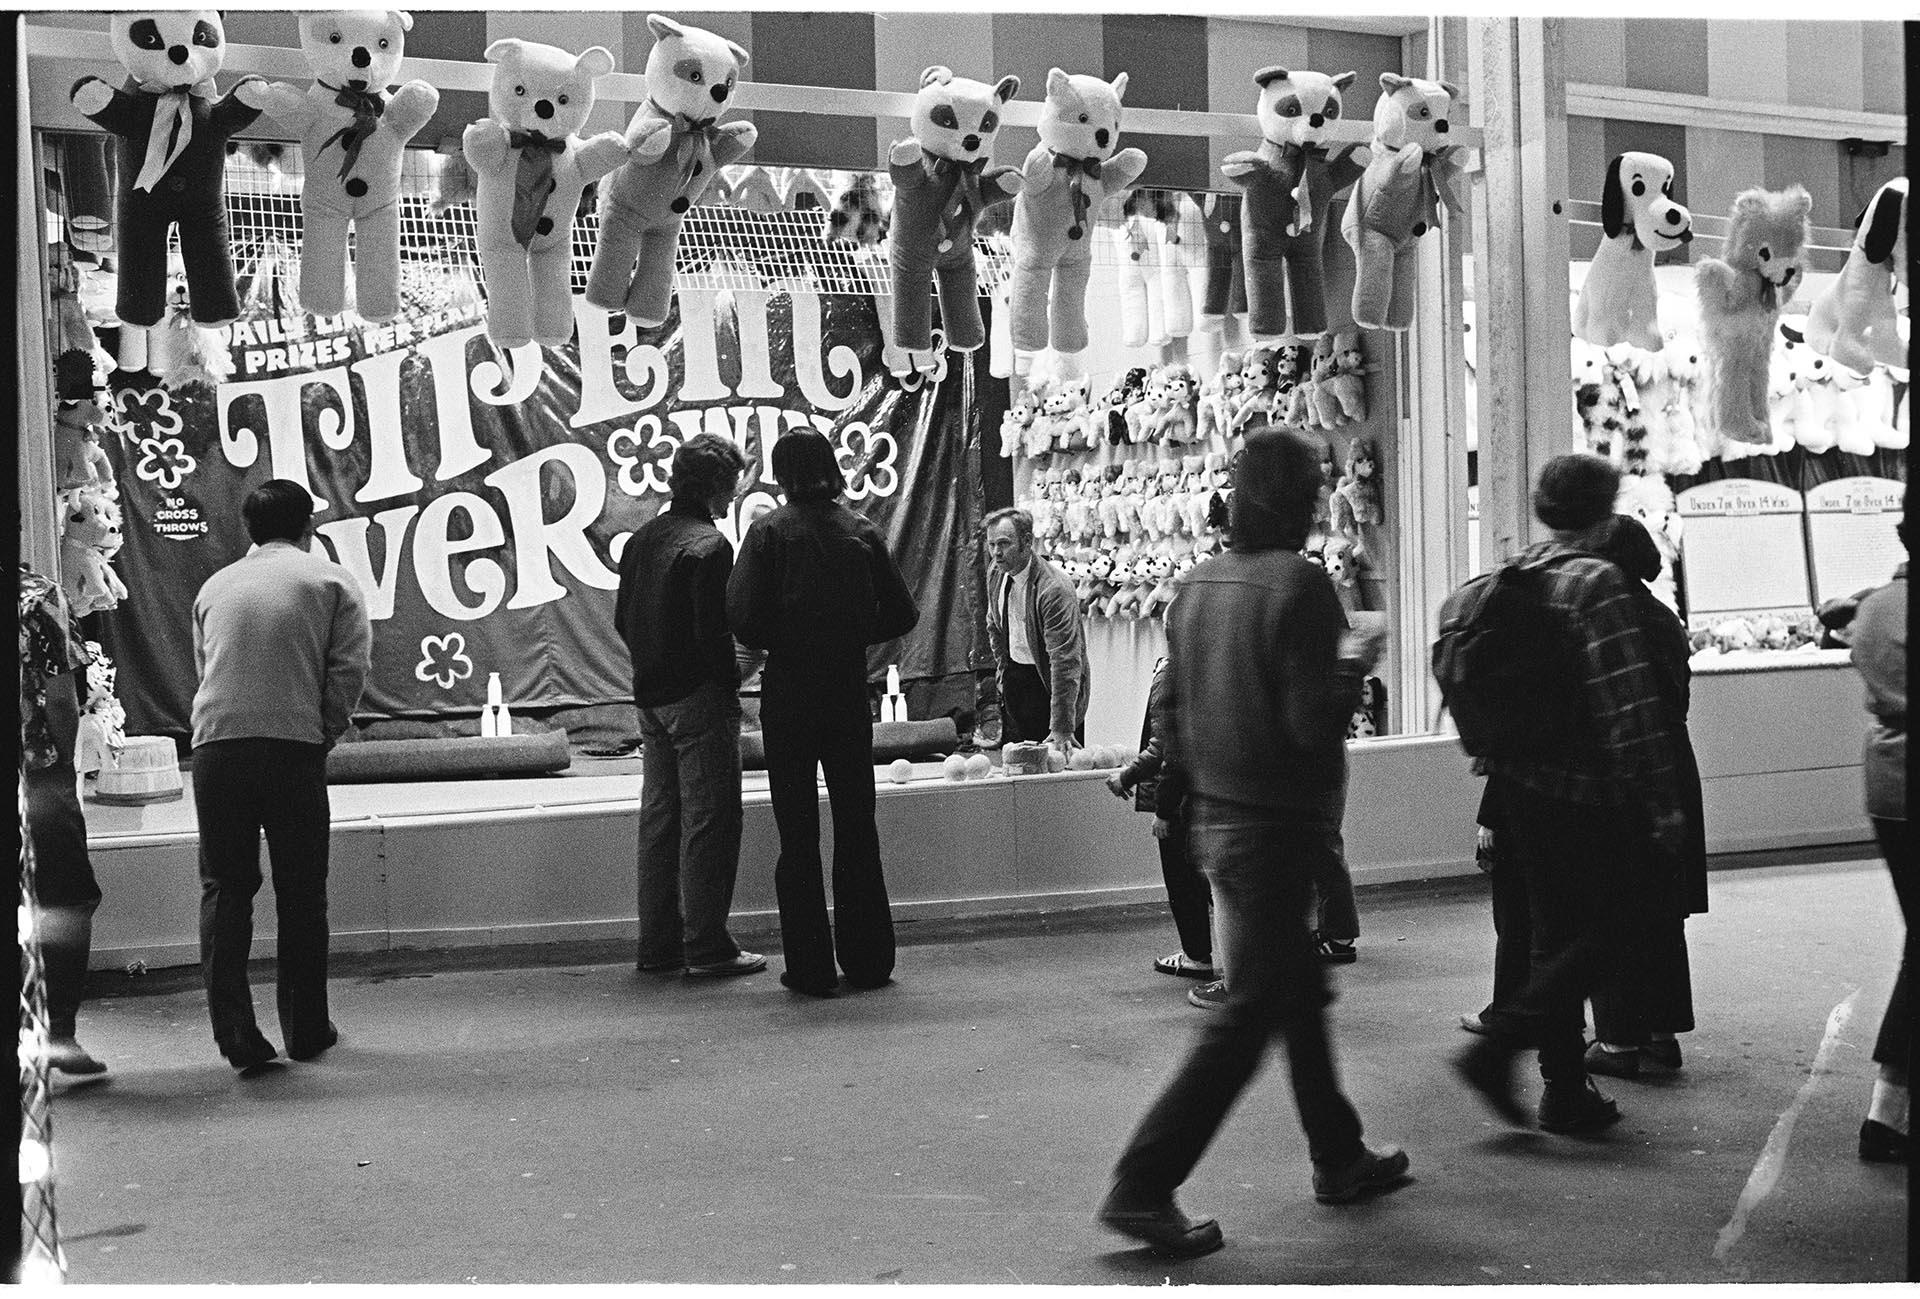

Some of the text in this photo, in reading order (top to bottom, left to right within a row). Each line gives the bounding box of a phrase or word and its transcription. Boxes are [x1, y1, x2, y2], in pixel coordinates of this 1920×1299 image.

[245, 336, 352, 374] PRIZES
[363, 323, 415, 354] PER
[423, 299, 489, 338] PLAYE
[166, 497, 185, 509] NO
[1717, 496, 1723, 509] 7
[155, 508, 199, 520] CROSS
[153, 521, 209, 533] THROWS
[246, 442, 634, 621] VeR
